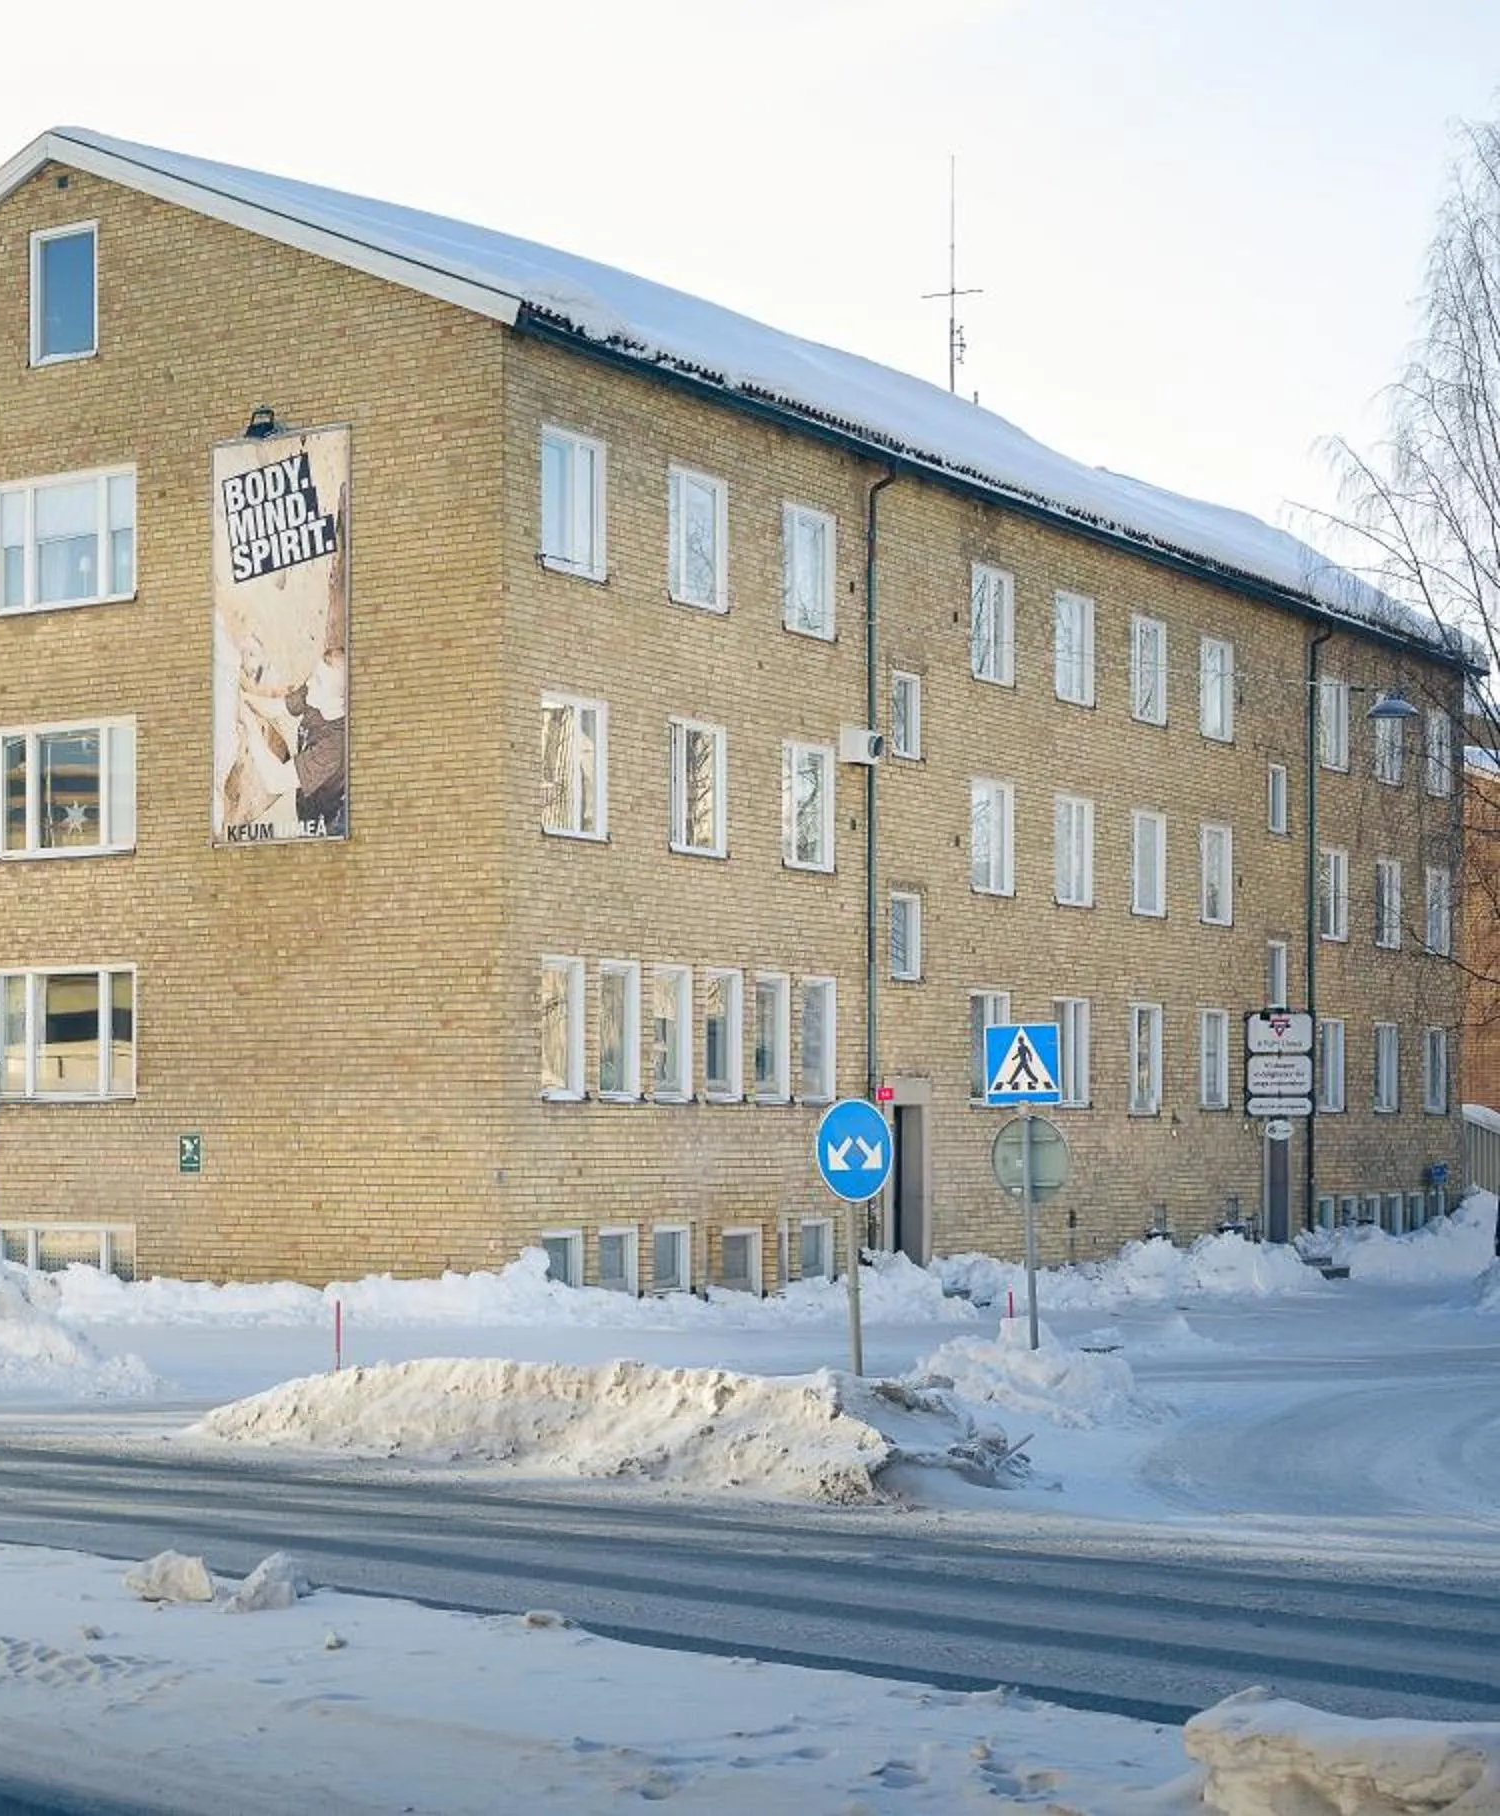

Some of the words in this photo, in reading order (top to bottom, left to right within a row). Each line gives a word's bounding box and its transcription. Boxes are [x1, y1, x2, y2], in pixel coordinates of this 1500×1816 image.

[224, 456, 309, 513] BODY.
[228, 491, 315, 547] MIND.
[233, 518, 334, 579] SPIRIT.
[227, 822, 273, 841] KFUM
